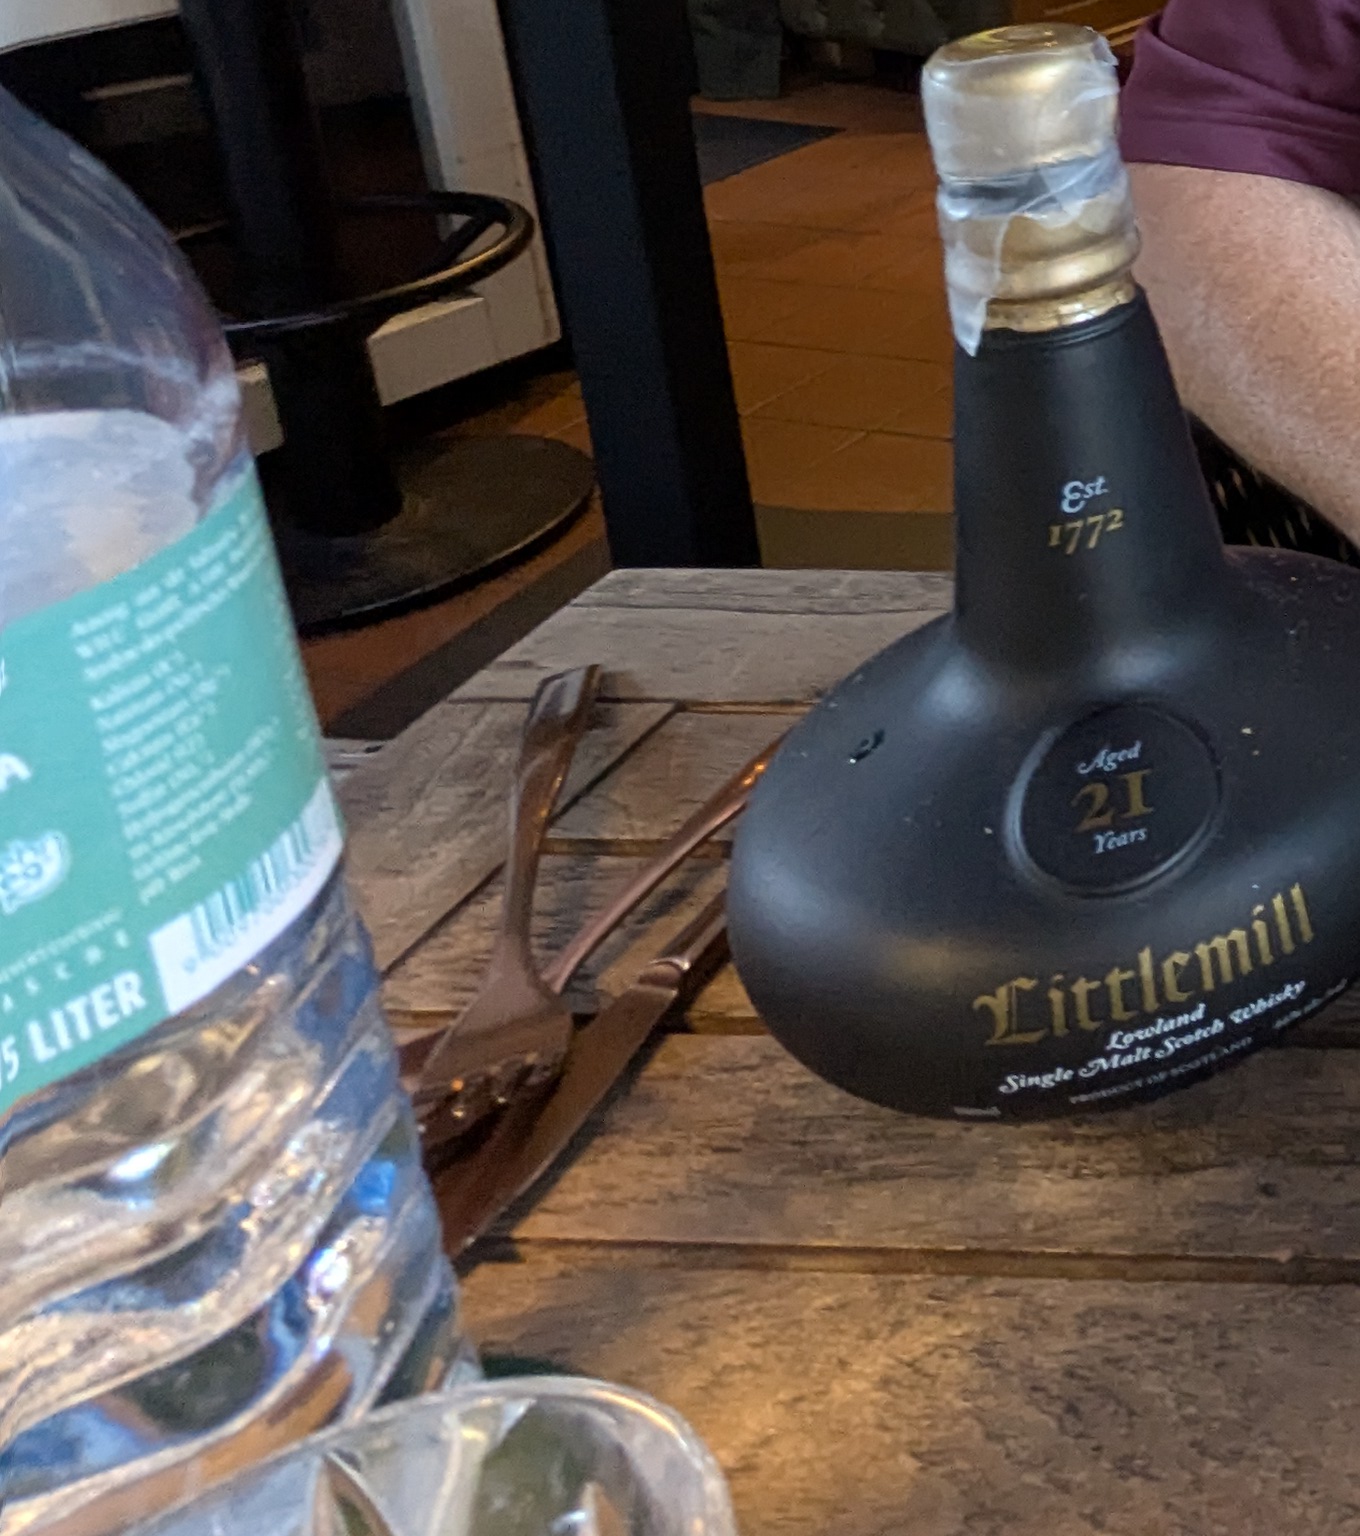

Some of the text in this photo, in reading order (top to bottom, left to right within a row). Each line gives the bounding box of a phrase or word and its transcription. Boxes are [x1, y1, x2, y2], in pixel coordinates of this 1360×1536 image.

[1048, 508, 1124, 555] 1772
[1076, 740, 1142, 774] Aged
[1070, 769, 1154, 834] 21
[1093, 828, 1148, 854] Years
[972, 882, 1314, 1046] Littlemill
[27, 969, 147, 1063] LITER
[998, 1066, 1075, 1094] Single
[1078, 1046, 1153, 1079] Malt
[1154, 1017, 1225, 1059] Scotch
[1229, 980, 1306, 1025] Whisky
[1104, 1002, 1207, 1051] Lowland
